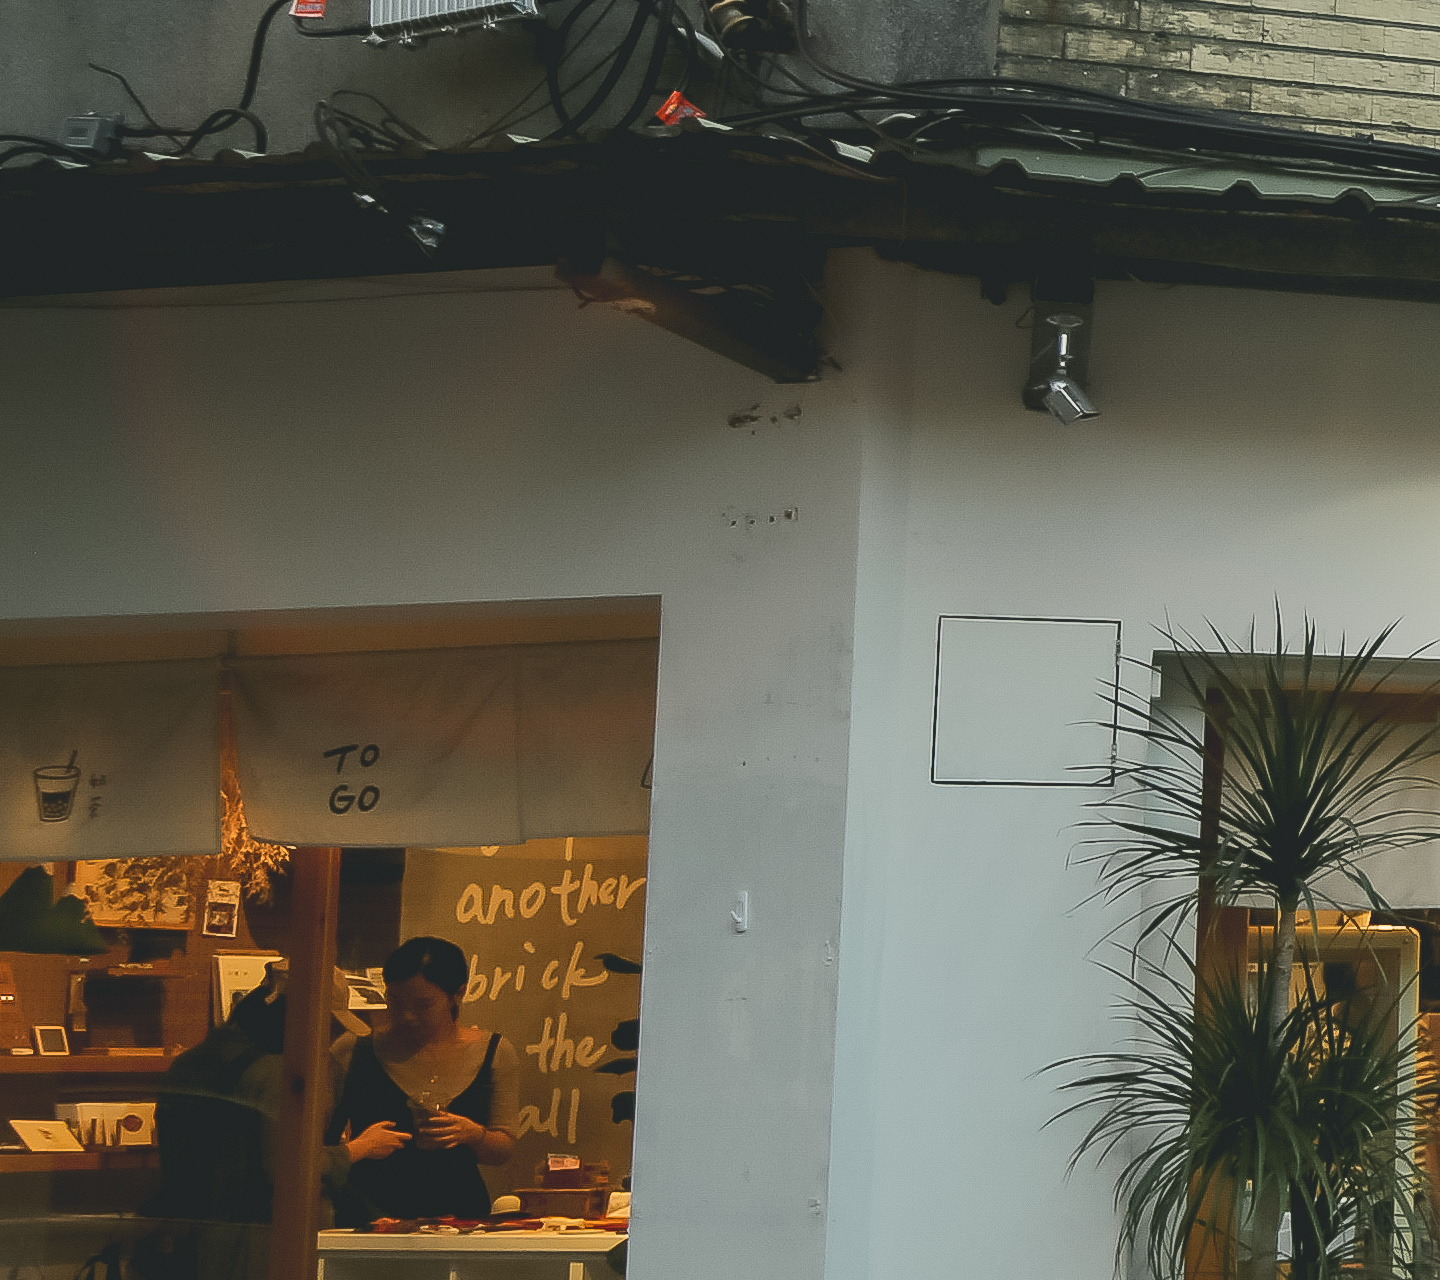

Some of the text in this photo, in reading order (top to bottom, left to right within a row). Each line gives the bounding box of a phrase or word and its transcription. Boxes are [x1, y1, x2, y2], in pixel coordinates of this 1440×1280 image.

[323, 744, 381, 774] TO
[329, 785, 381, 815] GO
[455, 863, 646, 925] another
[462, 941, 609, 1003] brick
[526, 1012, 608, 1073] the
[516, 1088, 581, 1144] all
